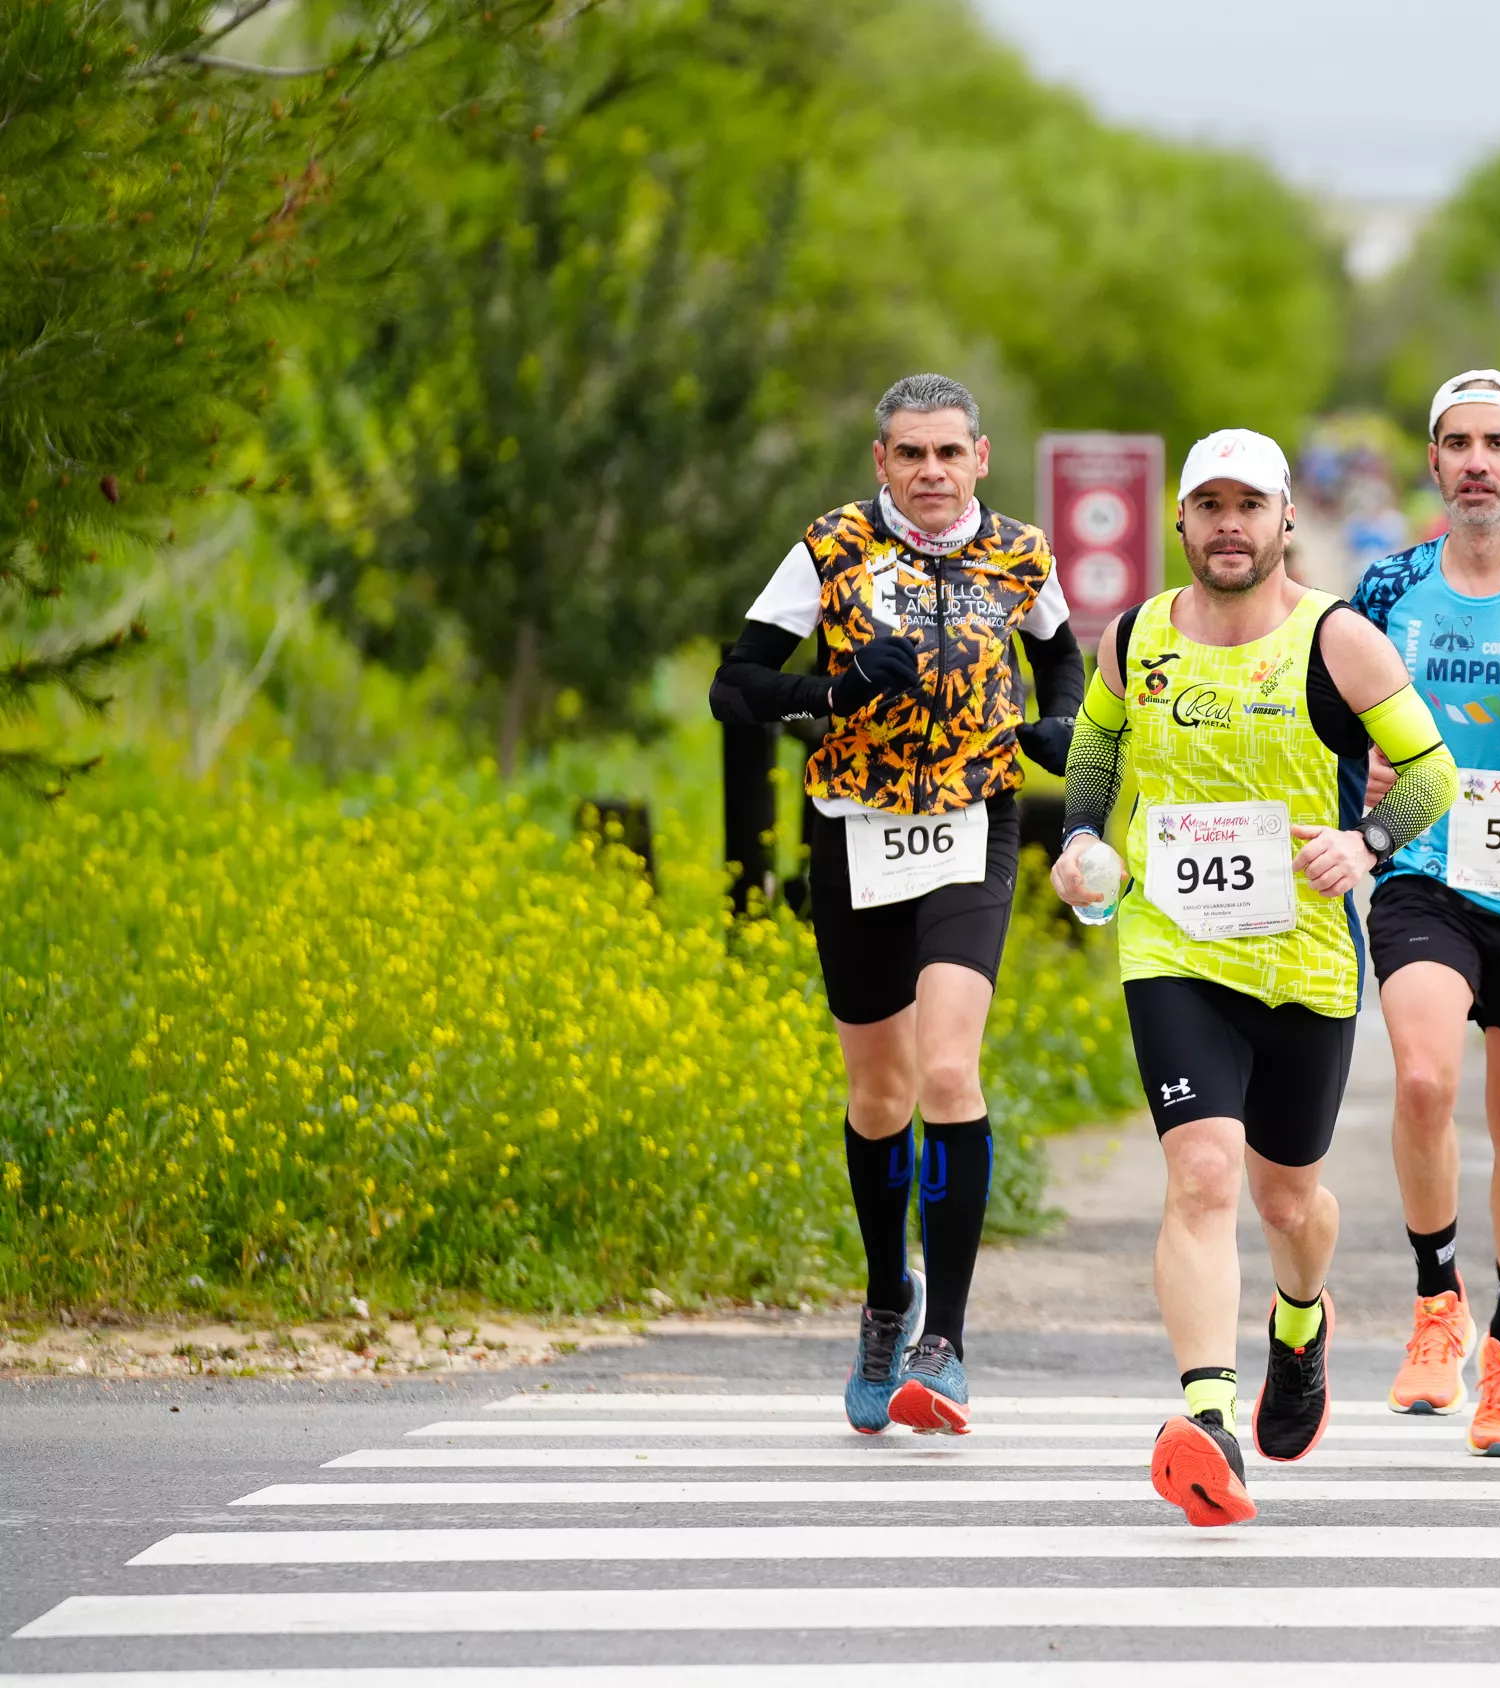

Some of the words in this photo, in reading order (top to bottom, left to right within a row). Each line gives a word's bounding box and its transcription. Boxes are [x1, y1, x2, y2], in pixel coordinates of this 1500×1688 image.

[904, 584, 984, 600] CASTILLO
[965, 600, 1008, 617] TRAIL
[1201, 719, 1231, 729] METAL
[884, 823, 955, 861] 506
[1194, 829, 1241, 843] LUCENA
[1177, 855, 1255, 894] 943
